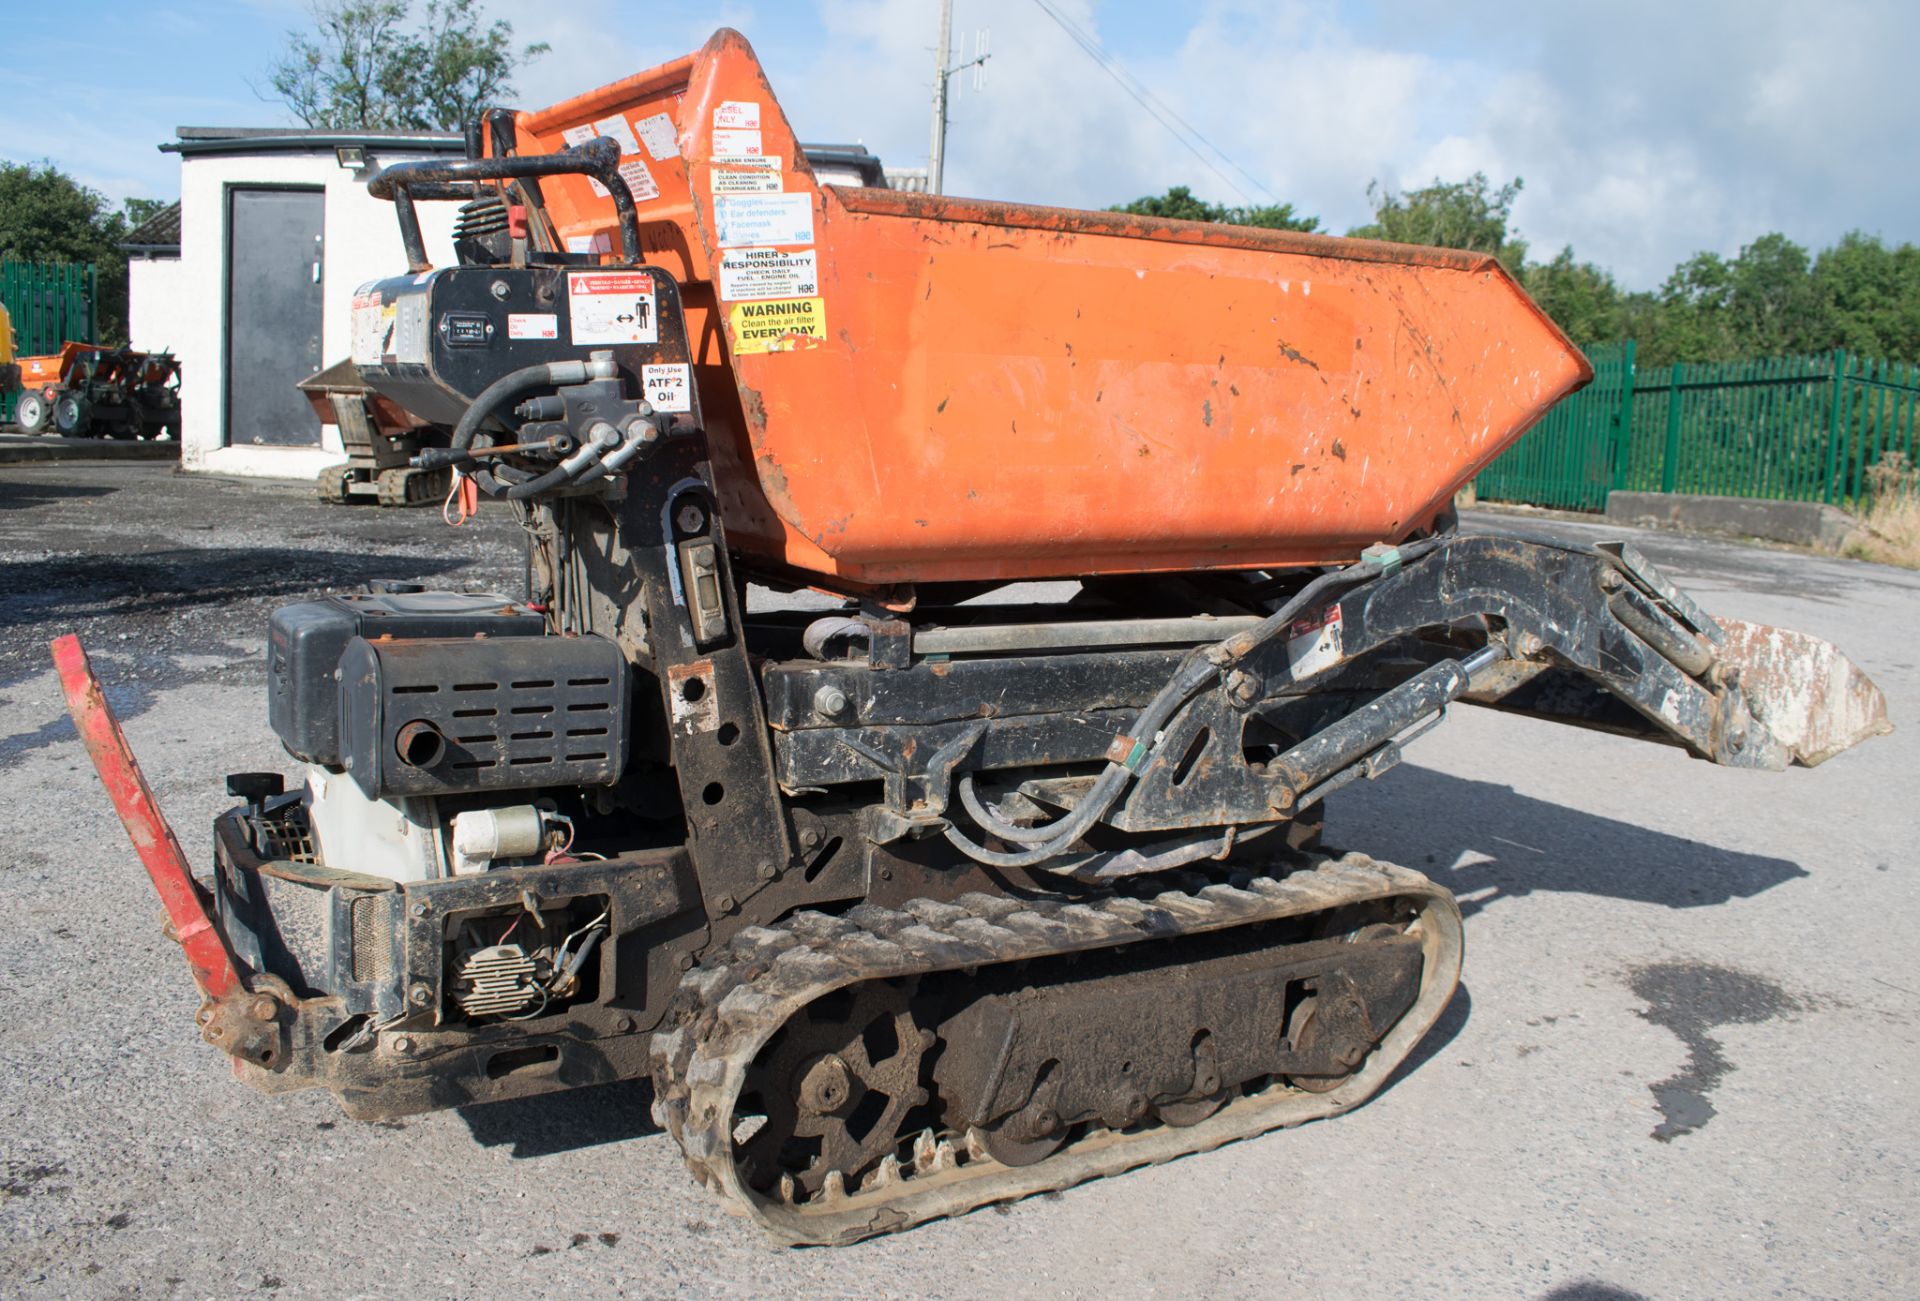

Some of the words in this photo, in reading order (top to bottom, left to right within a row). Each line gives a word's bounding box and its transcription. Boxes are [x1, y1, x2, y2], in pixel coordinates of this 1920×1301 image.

[729, 197, 763, 207] Goggles
[730, 210, 744, 218] Ear
[746, 208, 787, 217] defenders
[731, 220, 771, 228] Facemask
[723, 258, 811, 269] RESPONSIBILITY
[742, 302, 813, 317] WARNING
[741, 319, 766, 329] Clean
[768, 318, 782, 327] the
[783, 316, 795, 325] air
[796, 315, 815, 325] filter
[742, 327, 785, 339] EVERY
[790, 325, 816, 336] DAY
[648, 366, 665, 375] Only
[667, 366, 682, 374] Use
[648, 378, 672, 388] ATF
[675, 377, 683, 387] 2
[657, 391, 674, 402] Oil
